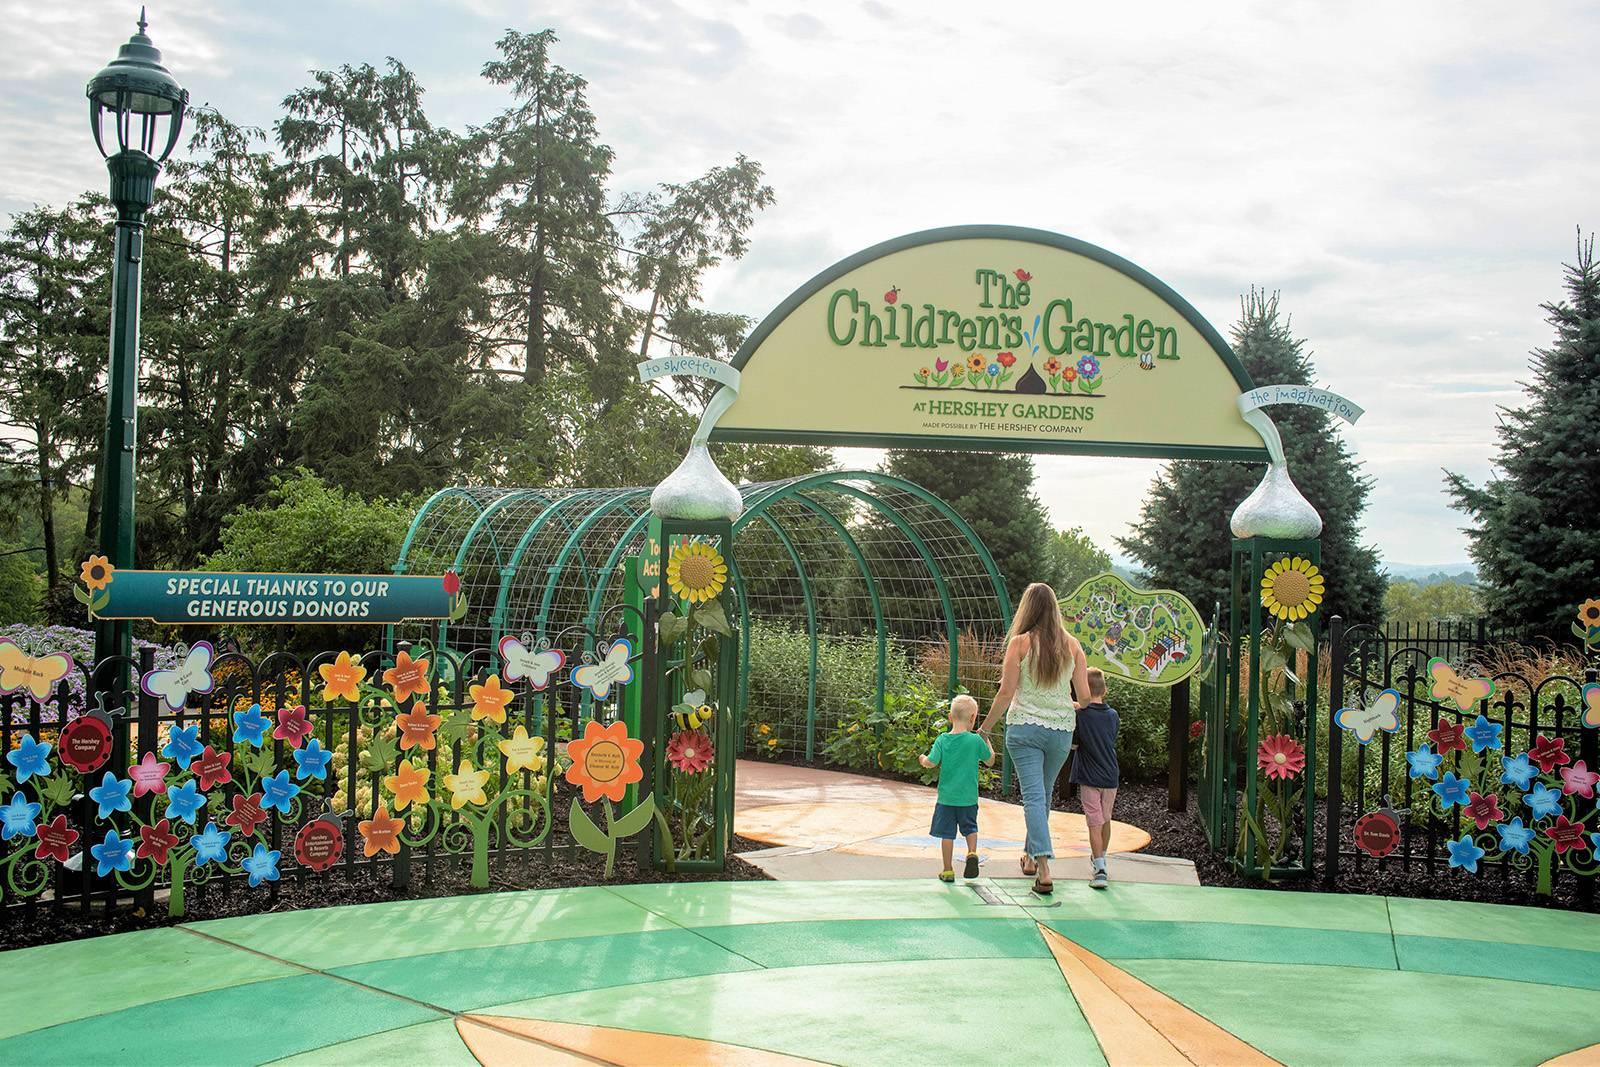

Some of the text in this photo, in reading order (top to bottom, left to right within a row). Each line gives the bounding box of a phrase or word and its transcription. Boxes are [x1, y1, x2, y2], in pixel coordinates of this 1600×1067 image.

[976, 269, 1031, 309] The
[827, 287, 1181, 360] Children's Garden
[646, 363, 660, 376] to
[1251, 391, 1269, 406] the
[913, 400, 1094, 421] AT HERSHEY GARDENS
[979, 422, 995, 430] THE
[998, 423, 1037, 432] HERSHEY
[1039, 424, 1083, 434] COMPANY
[166, 578, 390, 598] SPECIAL THANKS TO OUR
[187, 600, 370, 618] GENEROUS DONORS
[74, 744, 96, 752] Company
